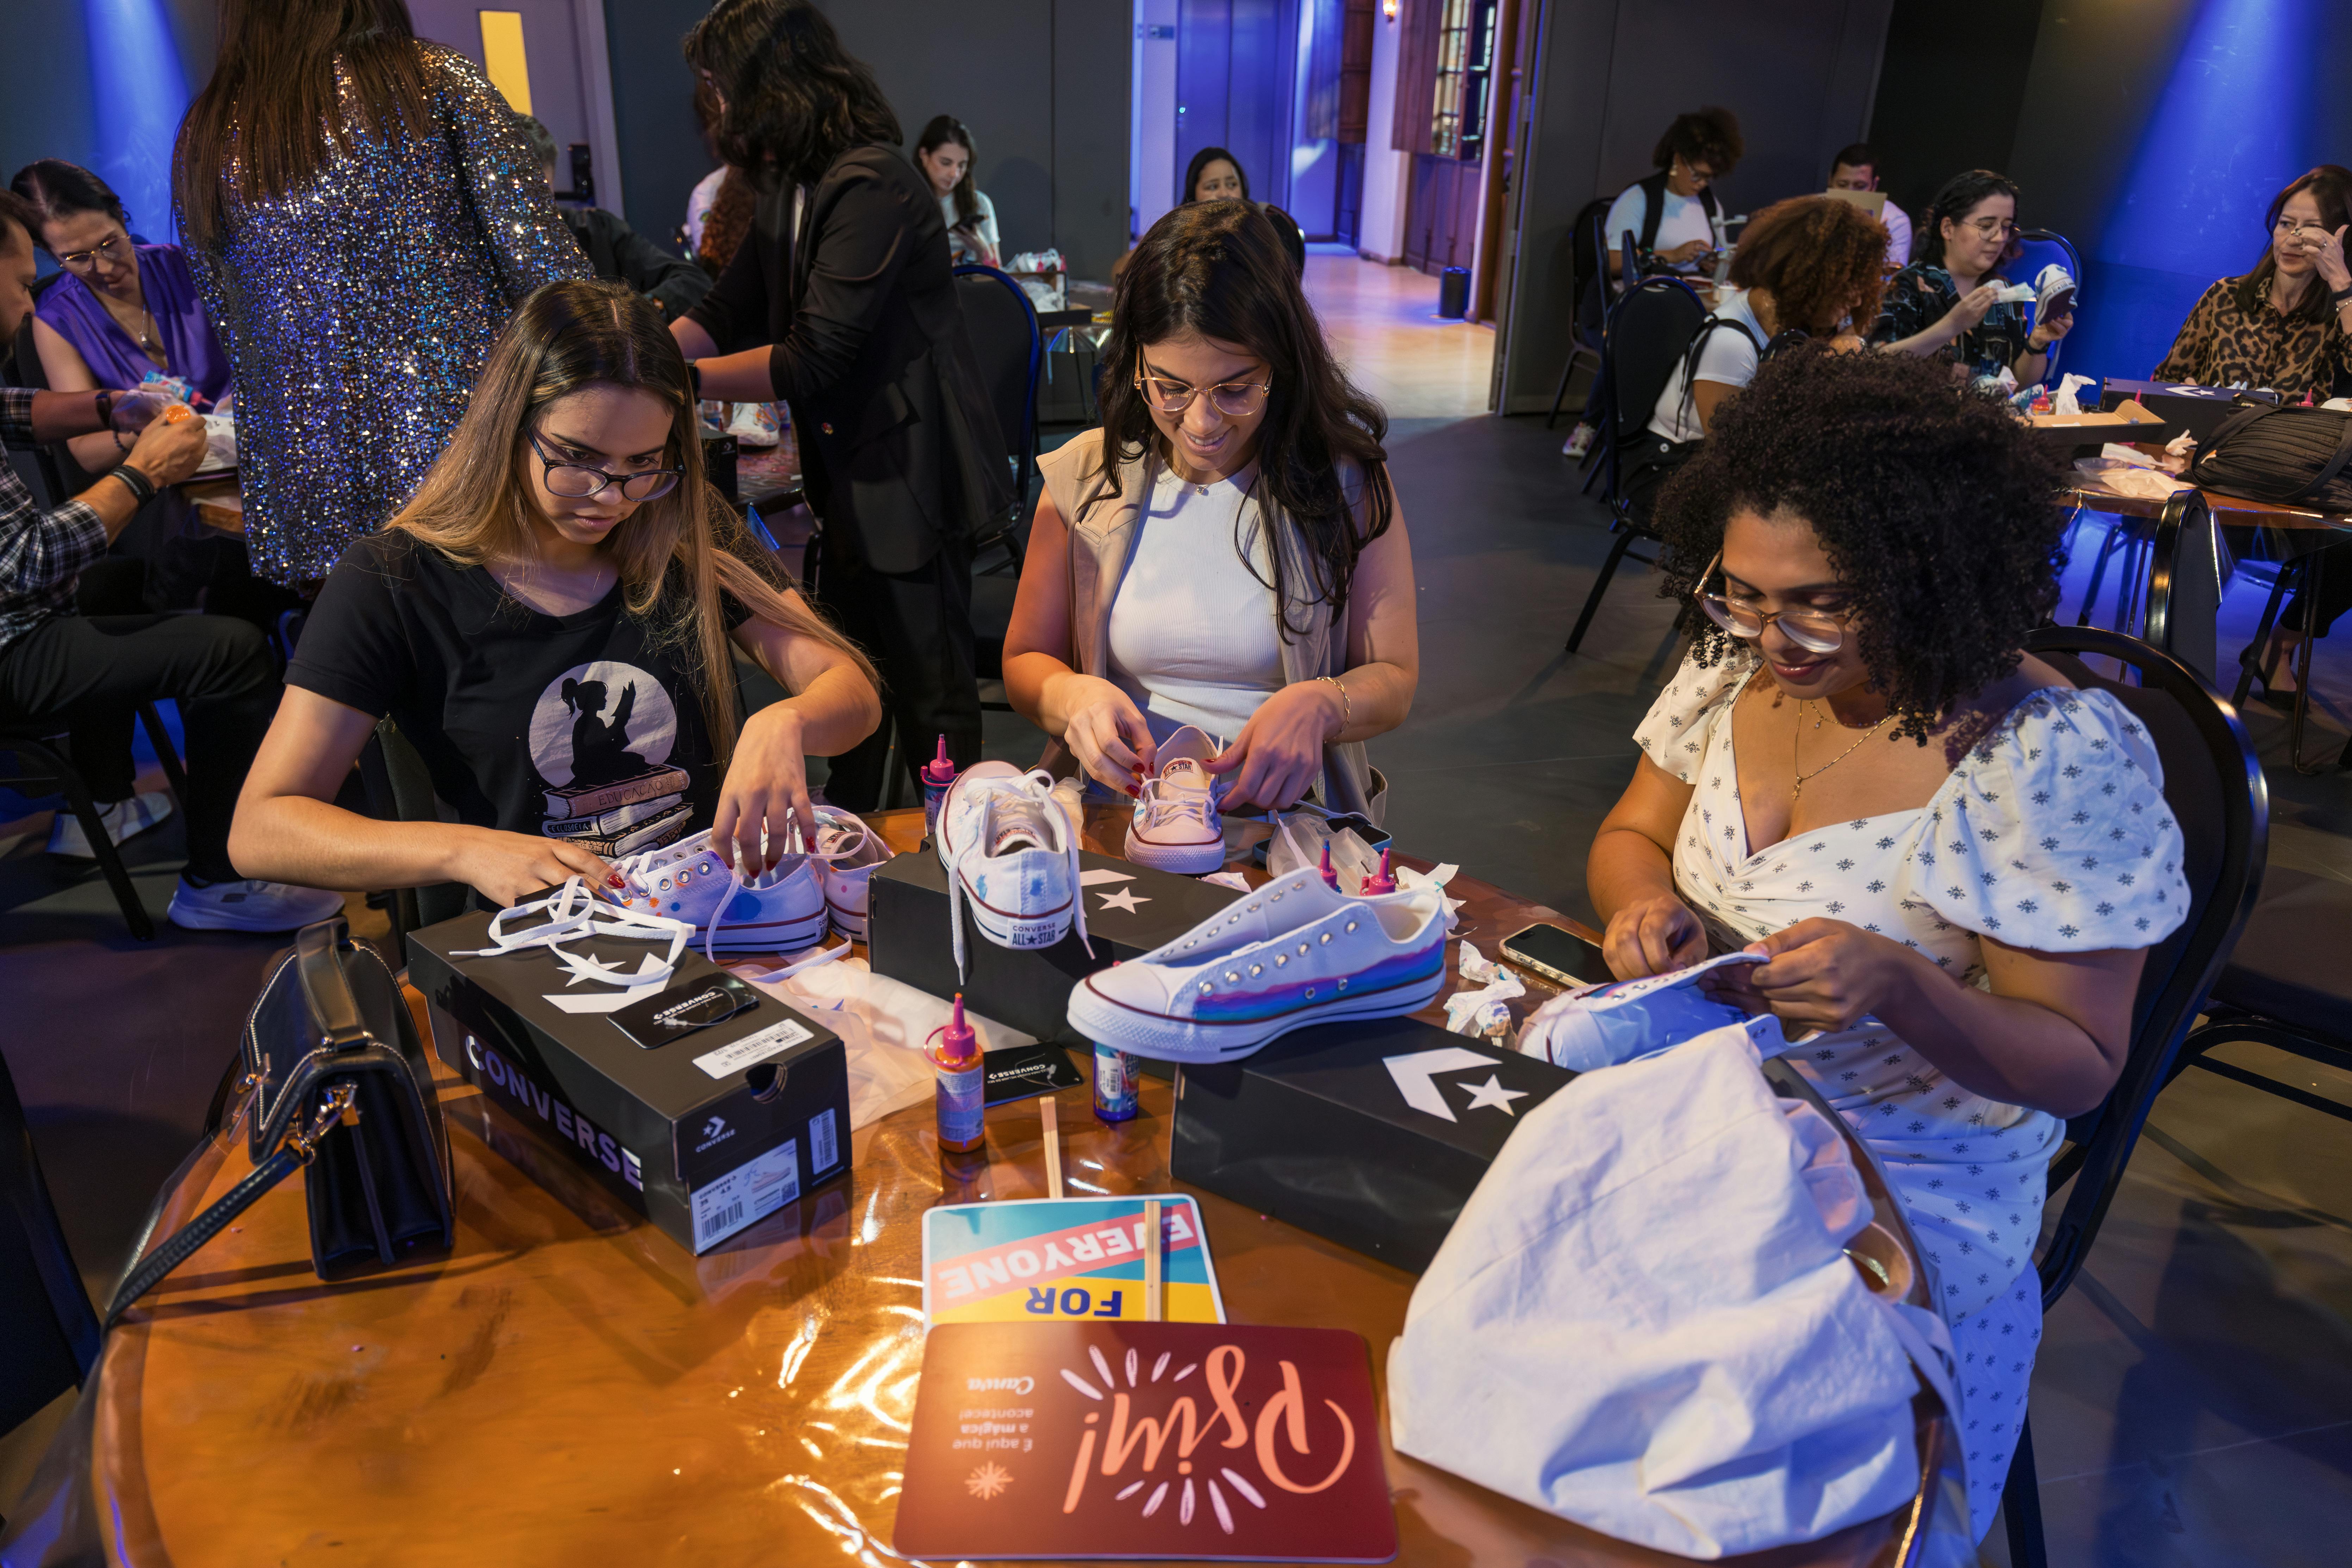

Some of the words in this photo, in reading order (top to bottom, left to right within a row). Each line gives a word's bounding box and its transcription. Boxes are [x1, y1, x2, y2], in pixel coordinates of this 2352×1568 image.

[1013, 922, 1055, 932] CONVERSE
[1012, 933, 1026, 945] ALL
[1038, 929, 1055, 944] STAR
[662, 991, 716, 1016] CONVERSE
[997, 1064, 1046, 1078] CONVERSE
[465, 1035, 644, 1192] CONVERSE
[696, 1128, 736, 1152] CONVERSE
[1025, 1287, 1122, 1318] FOR
[967, 1376, 1034, 1395] Canva
[959, 1408, 1034, 1421] acontece!
[961, 1421, 1016, 1436] mágica
[1020, 1423, 1029, 1433] a
[952, 1438, 983, 1449] que
[986, 1437, 1020, 1451] aqui
